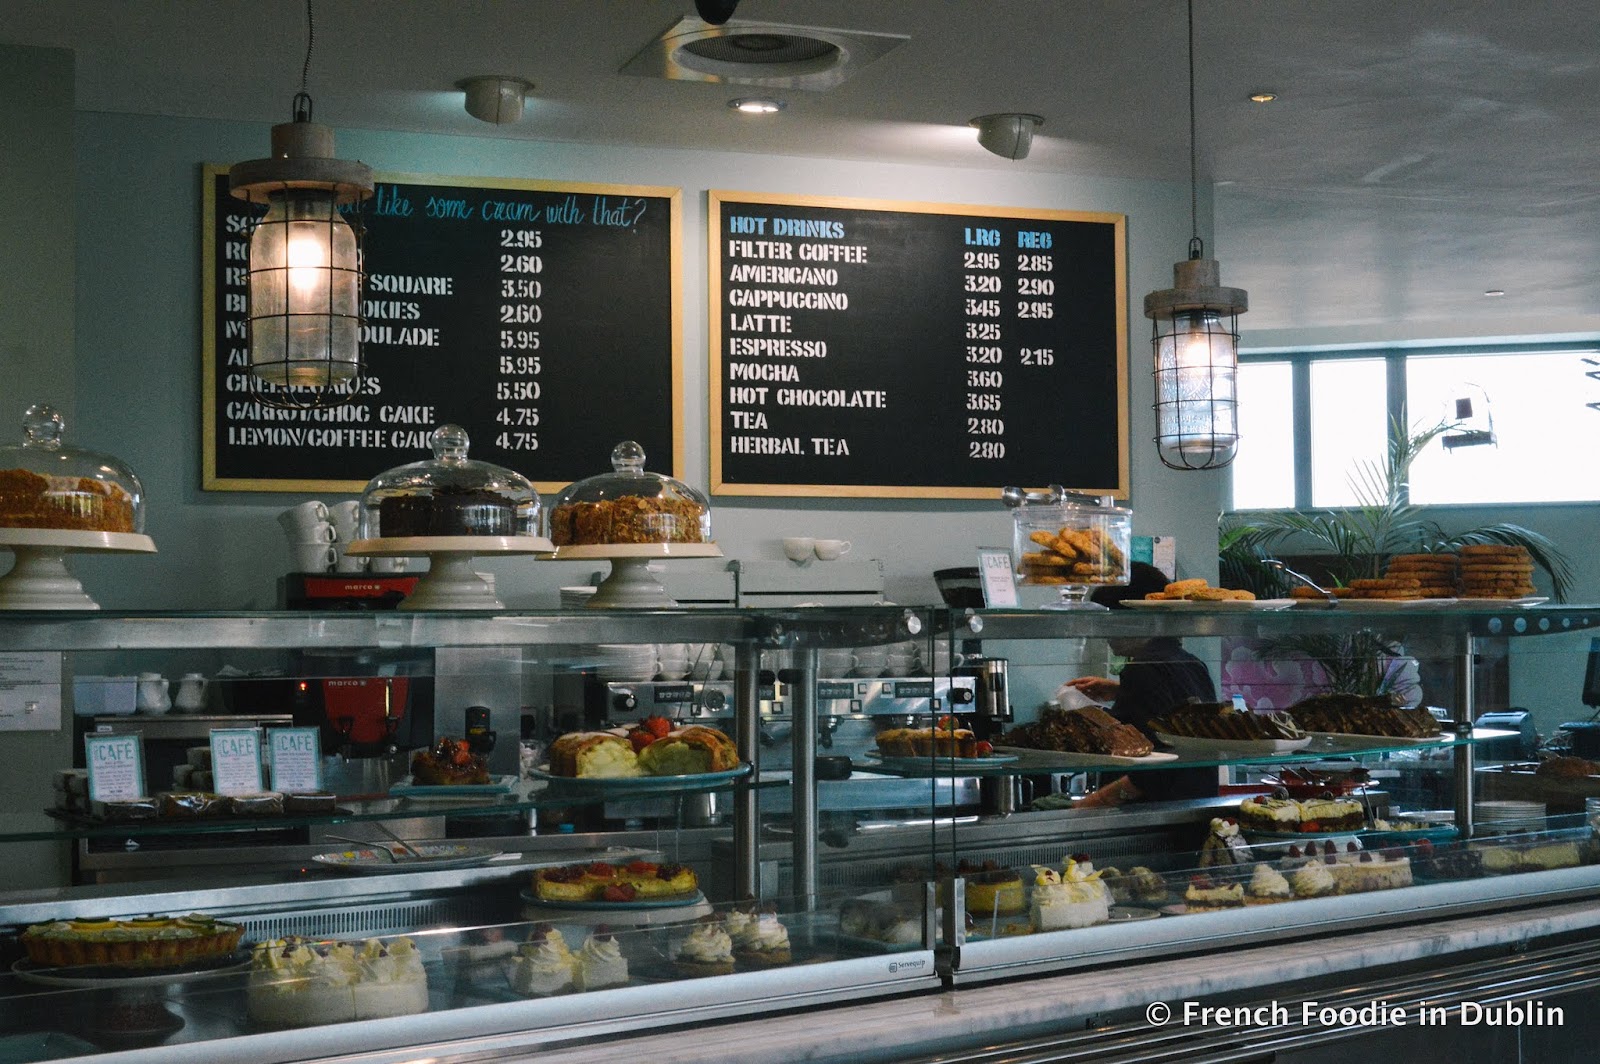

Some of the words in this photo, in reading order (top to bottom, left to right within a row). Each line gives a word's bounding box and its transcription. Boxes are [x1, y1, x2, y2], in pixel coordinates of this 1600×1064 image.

[375, 183, 415, 218] like
[425, 196, 474, 222] some
[480, 198, 540, 224] cream
[545, 195, 585, 226] with
[592, 196, 647, 234] that?
[501, 230, 542, 248] 2.95
[730, 216, 767, 236] HOT
[773, 218, 845, 240] DRINKS
[964, 228, 1001, 247] LRG
[1017, 231, 1053, 250] REG
[501, 255, 542, 273] 2.60
[729, 240, 793, 261] FILTER
[798, 244, 868, 264] COFFEE
[964, 252, 1001, 270] 2.95
[1017, 254, 1053, 272] 2.85
[370, 273, 454, 296] SQUARE
[502, 280, 541, 298] 3.50
[729, 264, 838, 286] AMERICANO
[964, 275, 1002, 293] 3.20
[1017, 278, 1055, 296] 2.90
[362, 300, 421, 321] OKIES
[501, 304, 542, 323] 2.60
[729, 289, 848, 310] CAPPUCCINO
[1017, 302, 1054, 319] 2.95
[358, 325, 440, 347] OULADE
[501, 331, 539, 349] 5.95
[731, 313, 792, 333] LATTE
[966, 323, 1001, 341] 3.25
[730, 338, 827, 358] ESPRESSO
[966, 346, 1003, 364] 3.20
[1020, 348, 1054, 366] 2.15
[500, 356, 541, 374] 5.95
[730, 362, 800, 382] MOCHA
[967, 370, 1003, 388] 3.60
[497, 382, 540, 400] 5.50
[730, 387, 768, 405] HOT
[776, 388, 887, 408] CHOCOLATE
[966, 393, 1002, 411] 3.65
[379, 404, 435, 424] CAKE
[496, 408, 539, 426] 4.75
[730, 411, 768, 430] TEA
[967, 418, 1004, 435] 2.80
[228, 425, 387, 448] LEMON/COFFEE
[391, 429, 434, 449] CAK
[495, 432, 538, 450] 4.75
[731, 436, 805, 455] HERBAL
[811, 438, 850, 456] TEA
[969, 442, 1005, 459] 2.80
[98, 742, 134, 761] CAFÉ
[221, 737, 254, 755] CAFÉ
[281, 734, 312, 751] CAFÉ
[898, 959, 926, 968] Servequip
